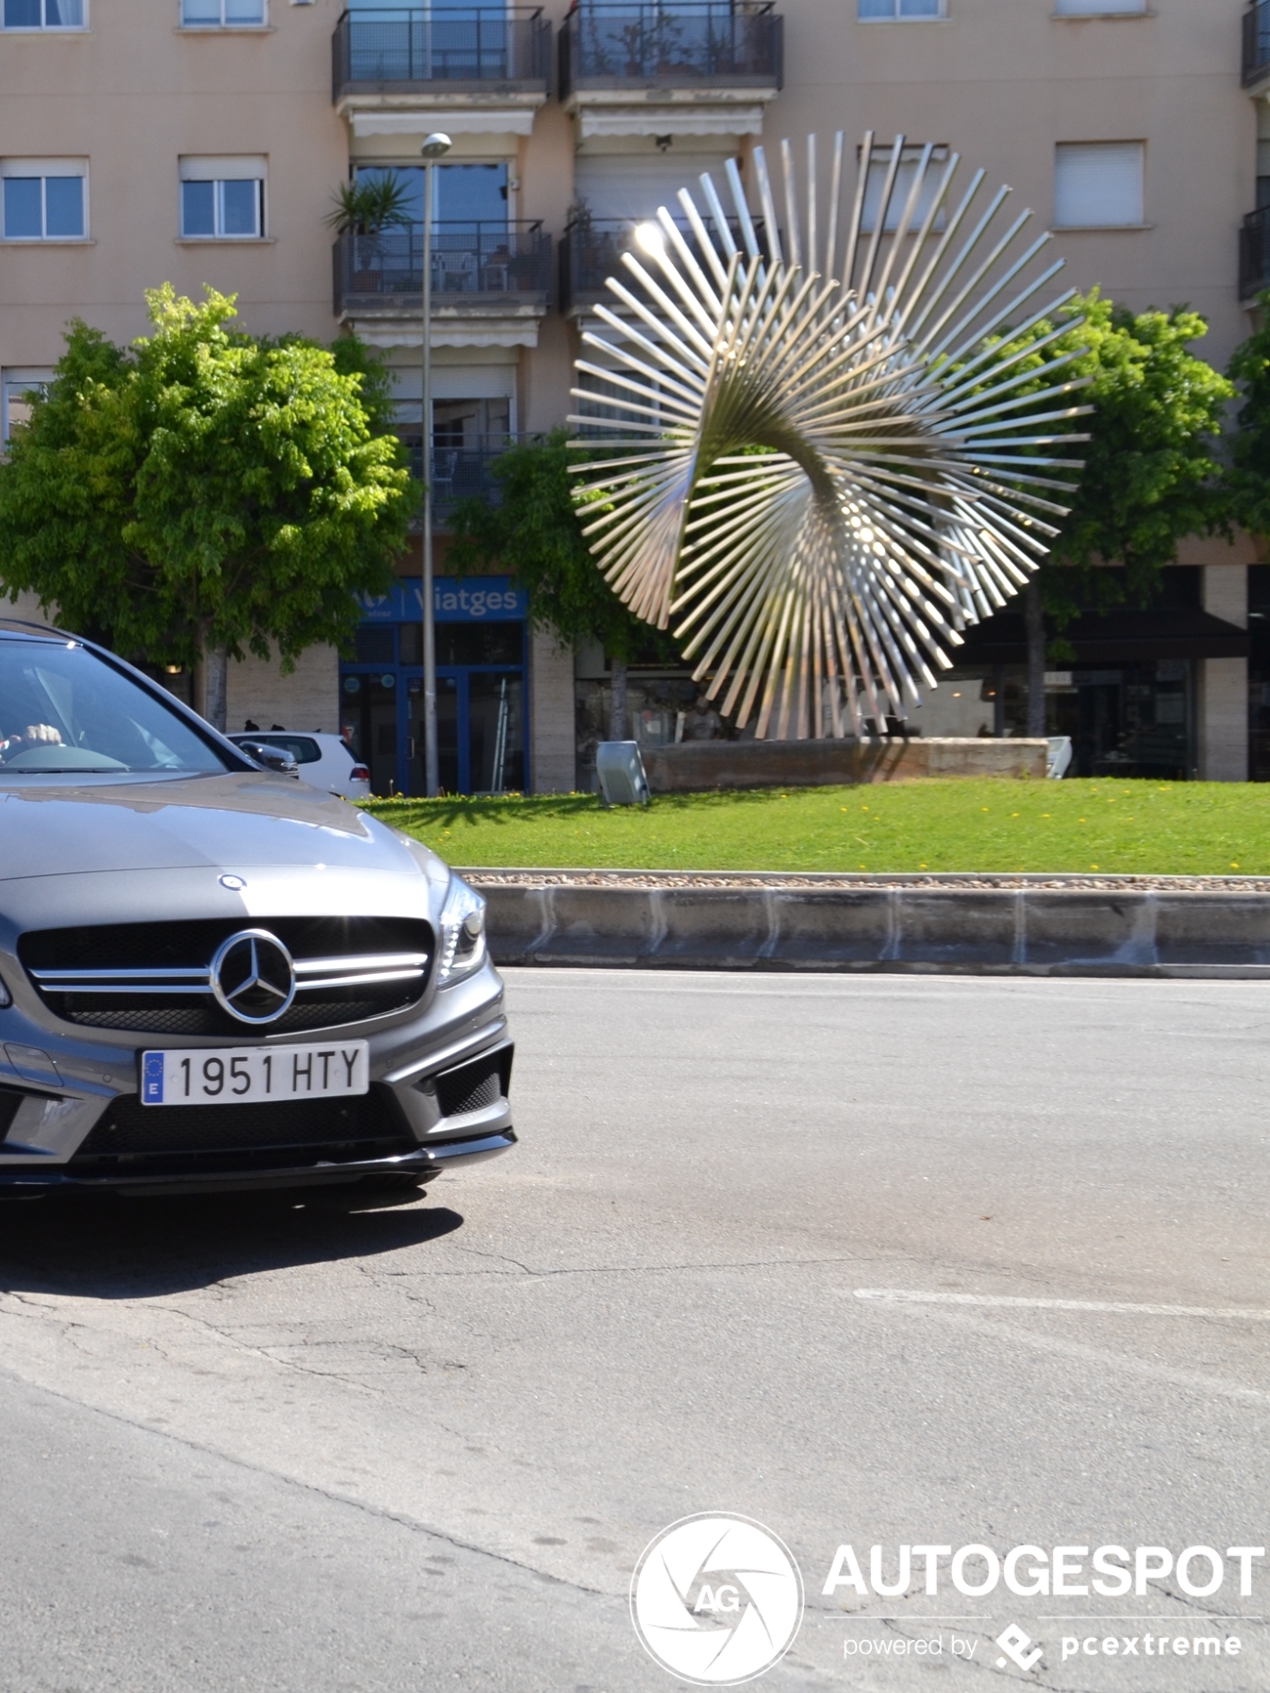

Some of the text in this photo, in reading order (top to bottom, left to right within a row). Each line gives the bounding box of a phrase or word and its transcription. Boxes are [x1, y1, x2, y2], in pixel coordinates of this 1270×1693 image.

[181, 1049, 360, 1097] 1951 HTY
[148, 1083, 159, 1095] E
